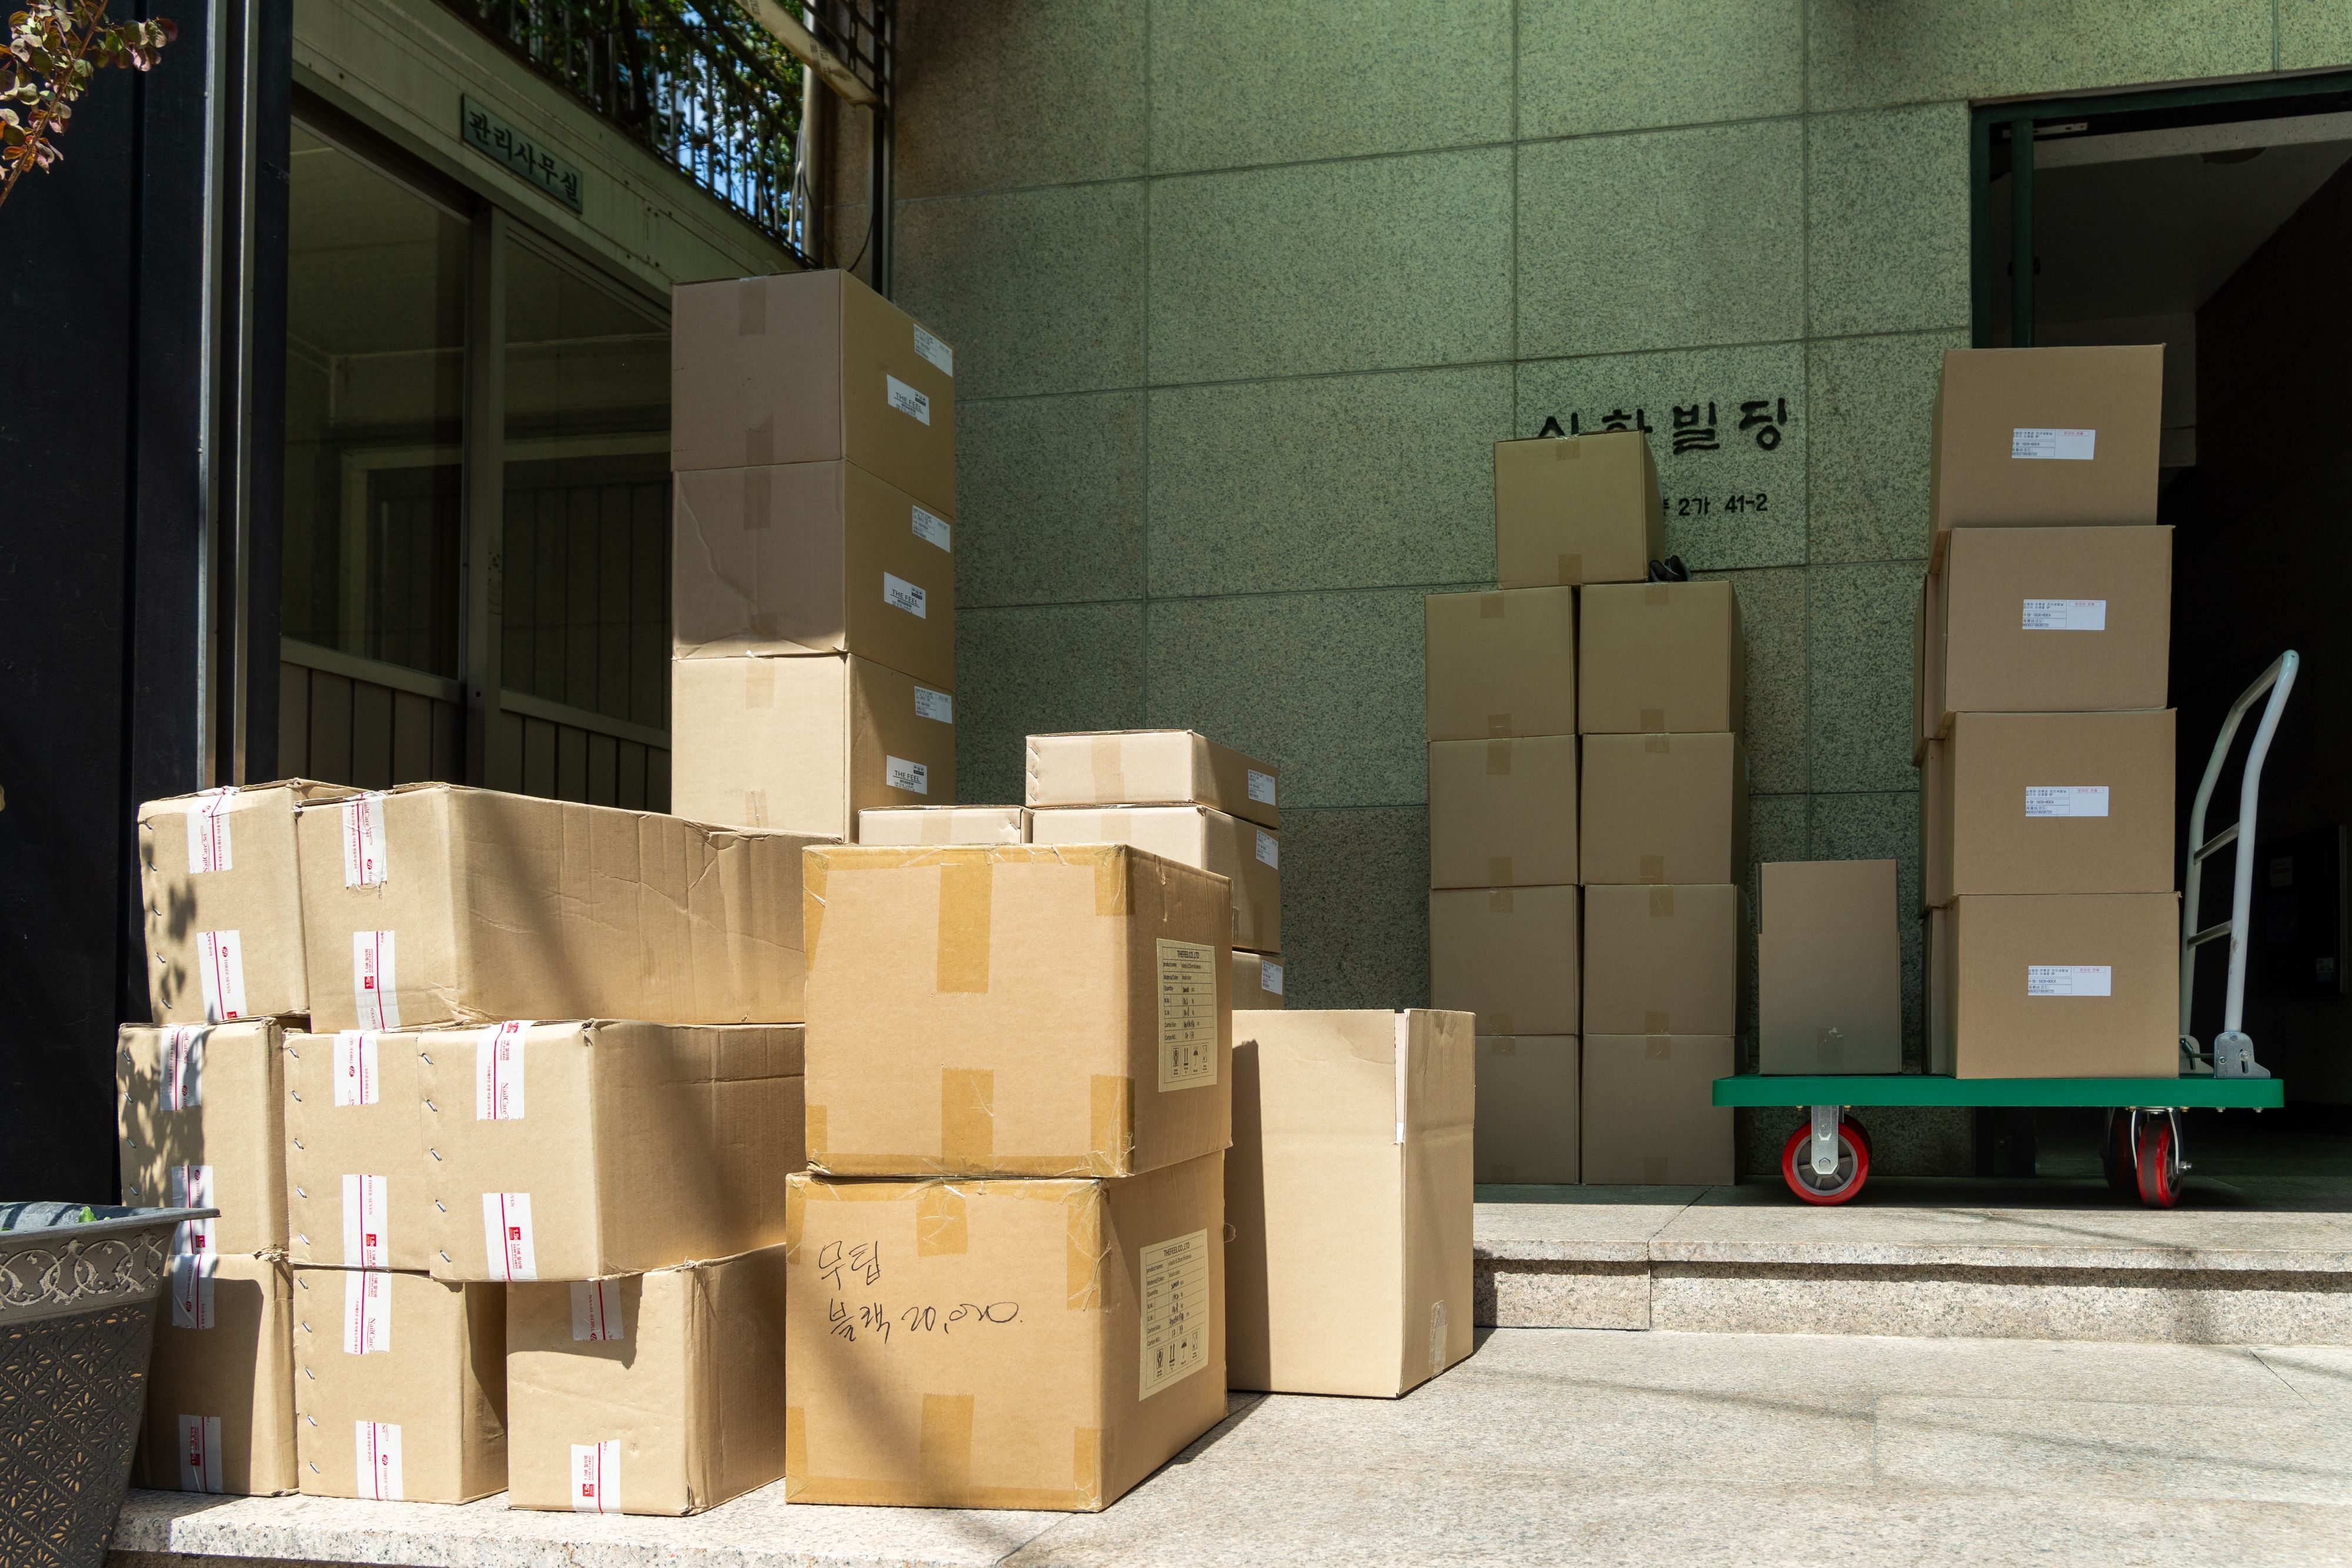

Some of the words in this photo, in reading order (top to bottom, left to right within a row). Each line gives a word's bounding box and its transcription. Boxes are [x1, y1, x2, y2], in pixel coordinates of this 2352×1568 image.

[468, 111, 579, 205] 관리사무실
[895, 392, 908, 404] THE
[908, 399, 923, 412] FEEL
[1725, 493, 1768, 513] 41-2
[891, 589, 904, 599] THE
[904, 595, 918, 606] FEEL
[894, 770, 906, 778] THE
[907, 773, 920, 783] FEEL
[830, 1298, 890, 1344] 블랙
